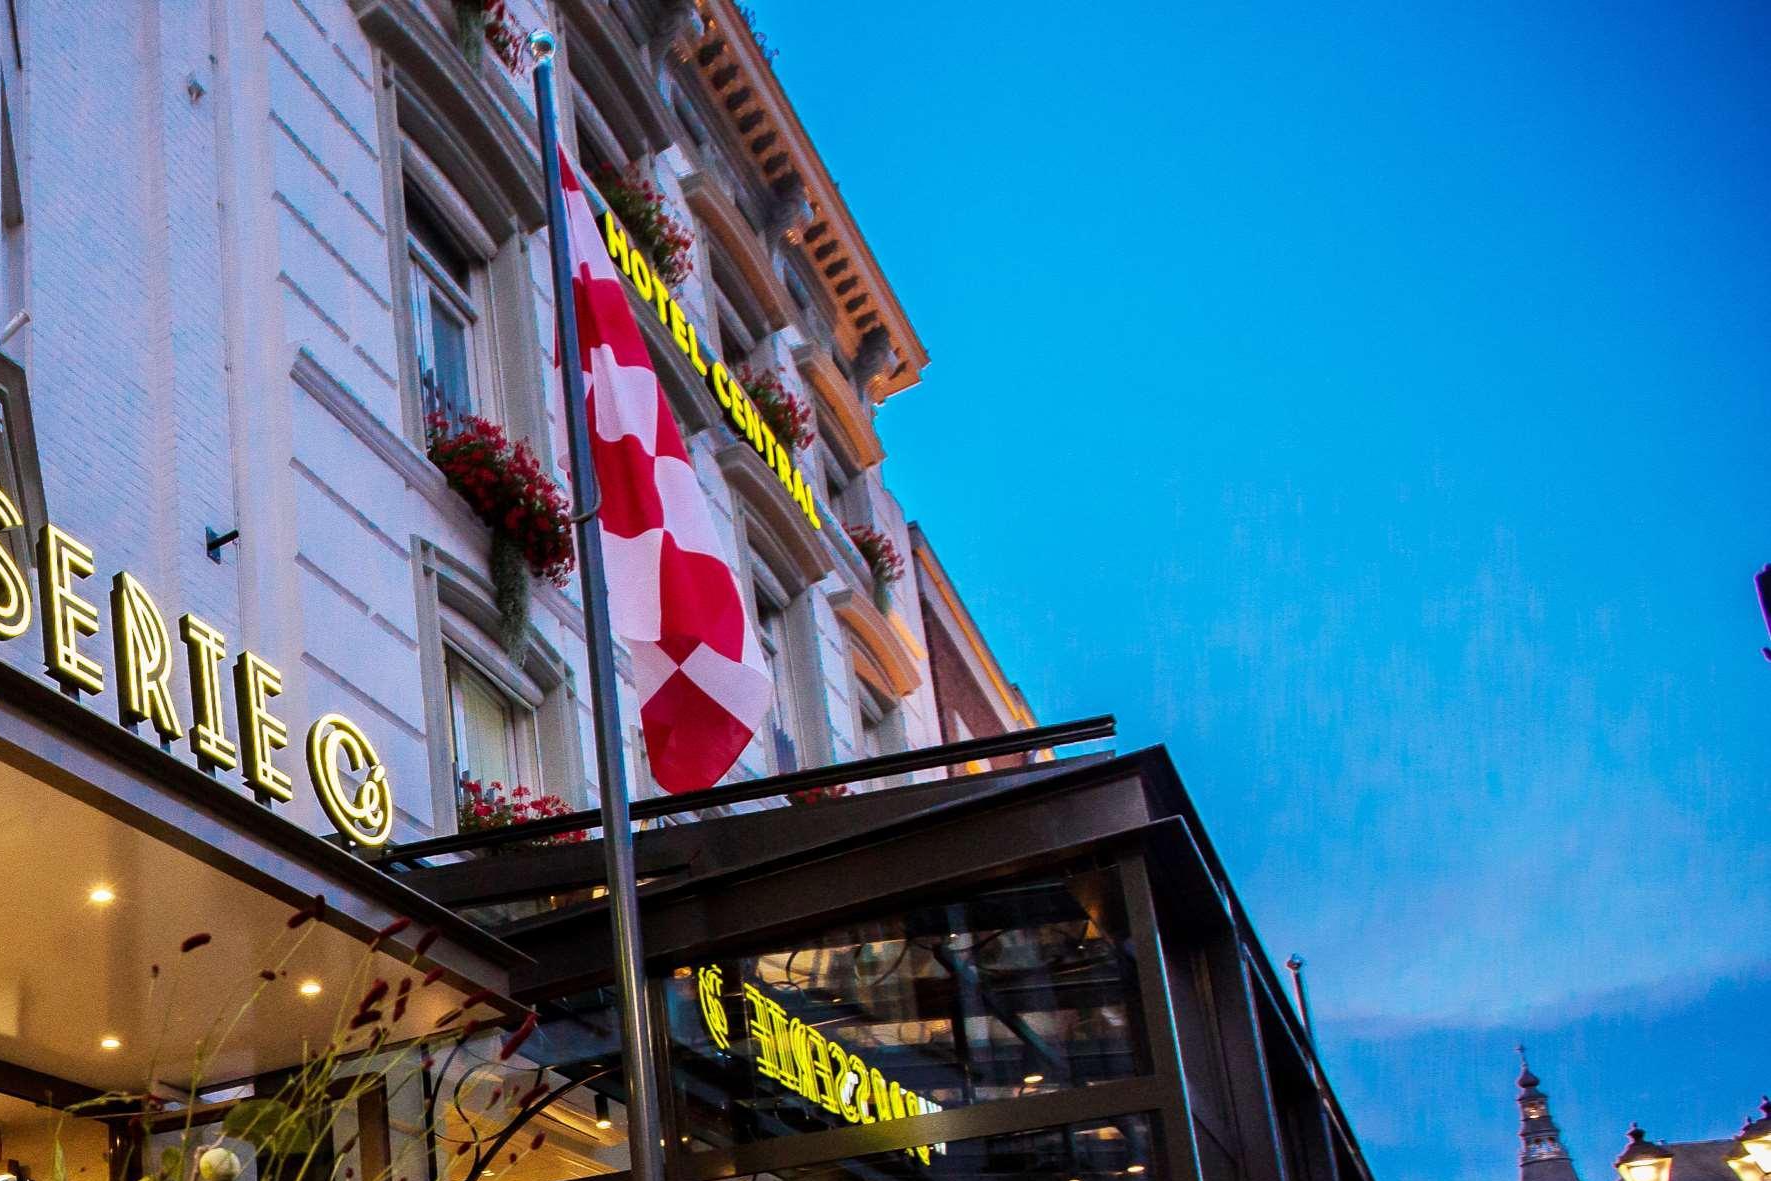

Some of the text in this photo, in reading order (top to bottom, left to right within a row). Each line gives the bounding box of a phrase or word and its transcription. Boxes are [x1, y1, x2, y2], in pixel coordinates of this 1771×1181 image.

[604, 209, 822, 530] HOTEL CENTRAL
[306, 712, 395, 847] Cé
